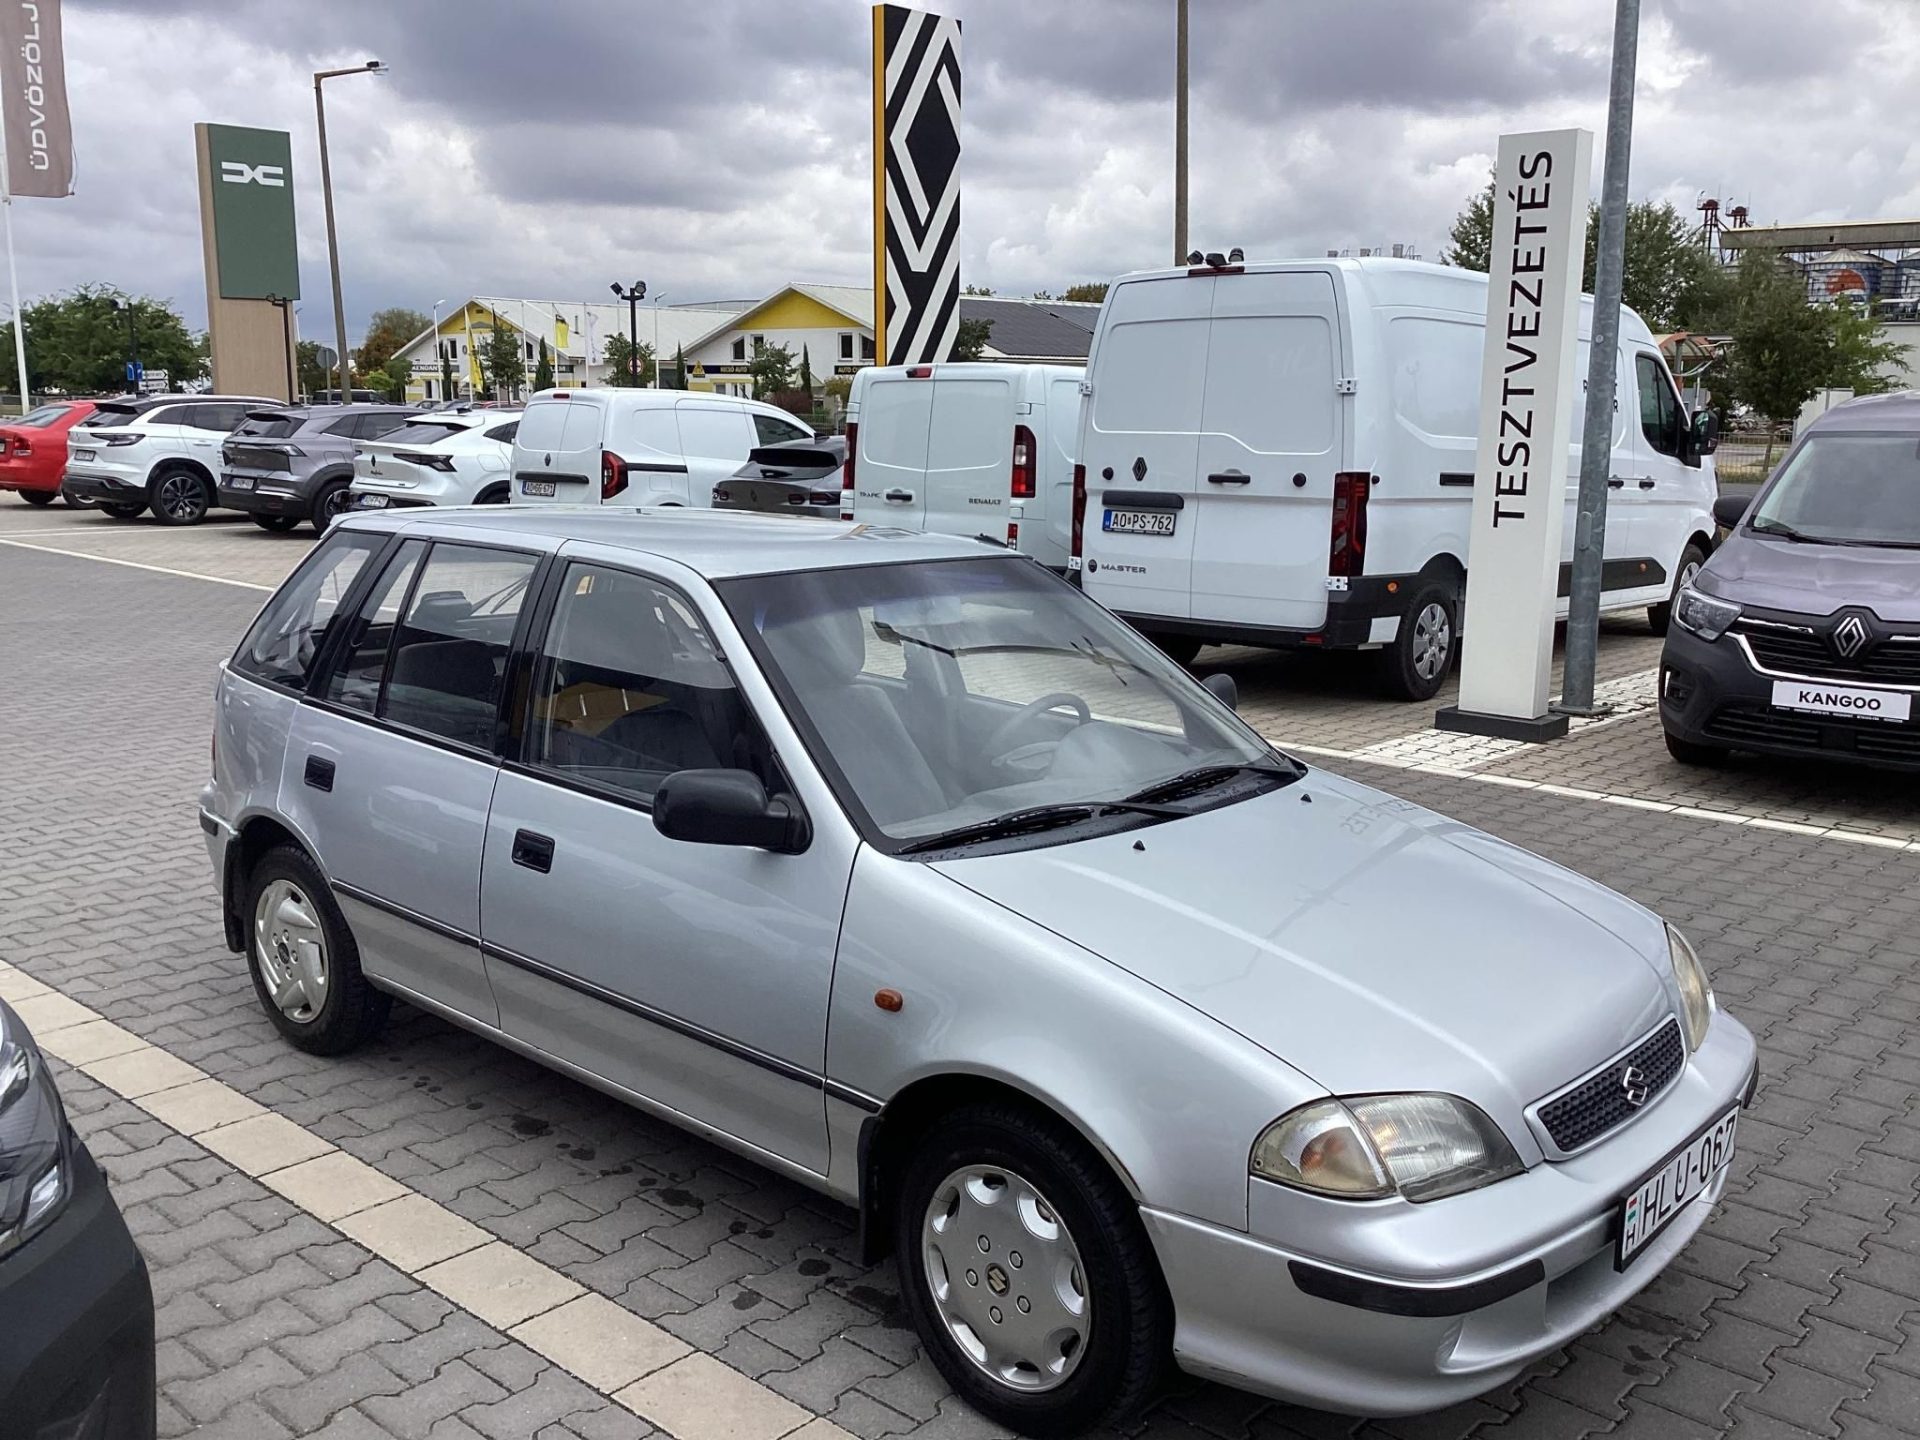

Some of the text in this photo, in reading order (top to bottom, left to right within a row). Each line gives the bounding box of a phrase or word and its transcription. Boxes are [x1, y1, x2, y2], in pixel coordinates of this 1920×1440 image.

[21, 0, 49, 170] ÜDVÖZÖLJ
[1492, 150, 1553, 528] TESZTVEZETÉS
[968, 497, 1001, 506] RENAULT
[1101, 563, 1147, 575] MASTER
[1798, 690, 1882, 711] KANGOO
[1641, 1113, 1736, 1236] HLU-067
